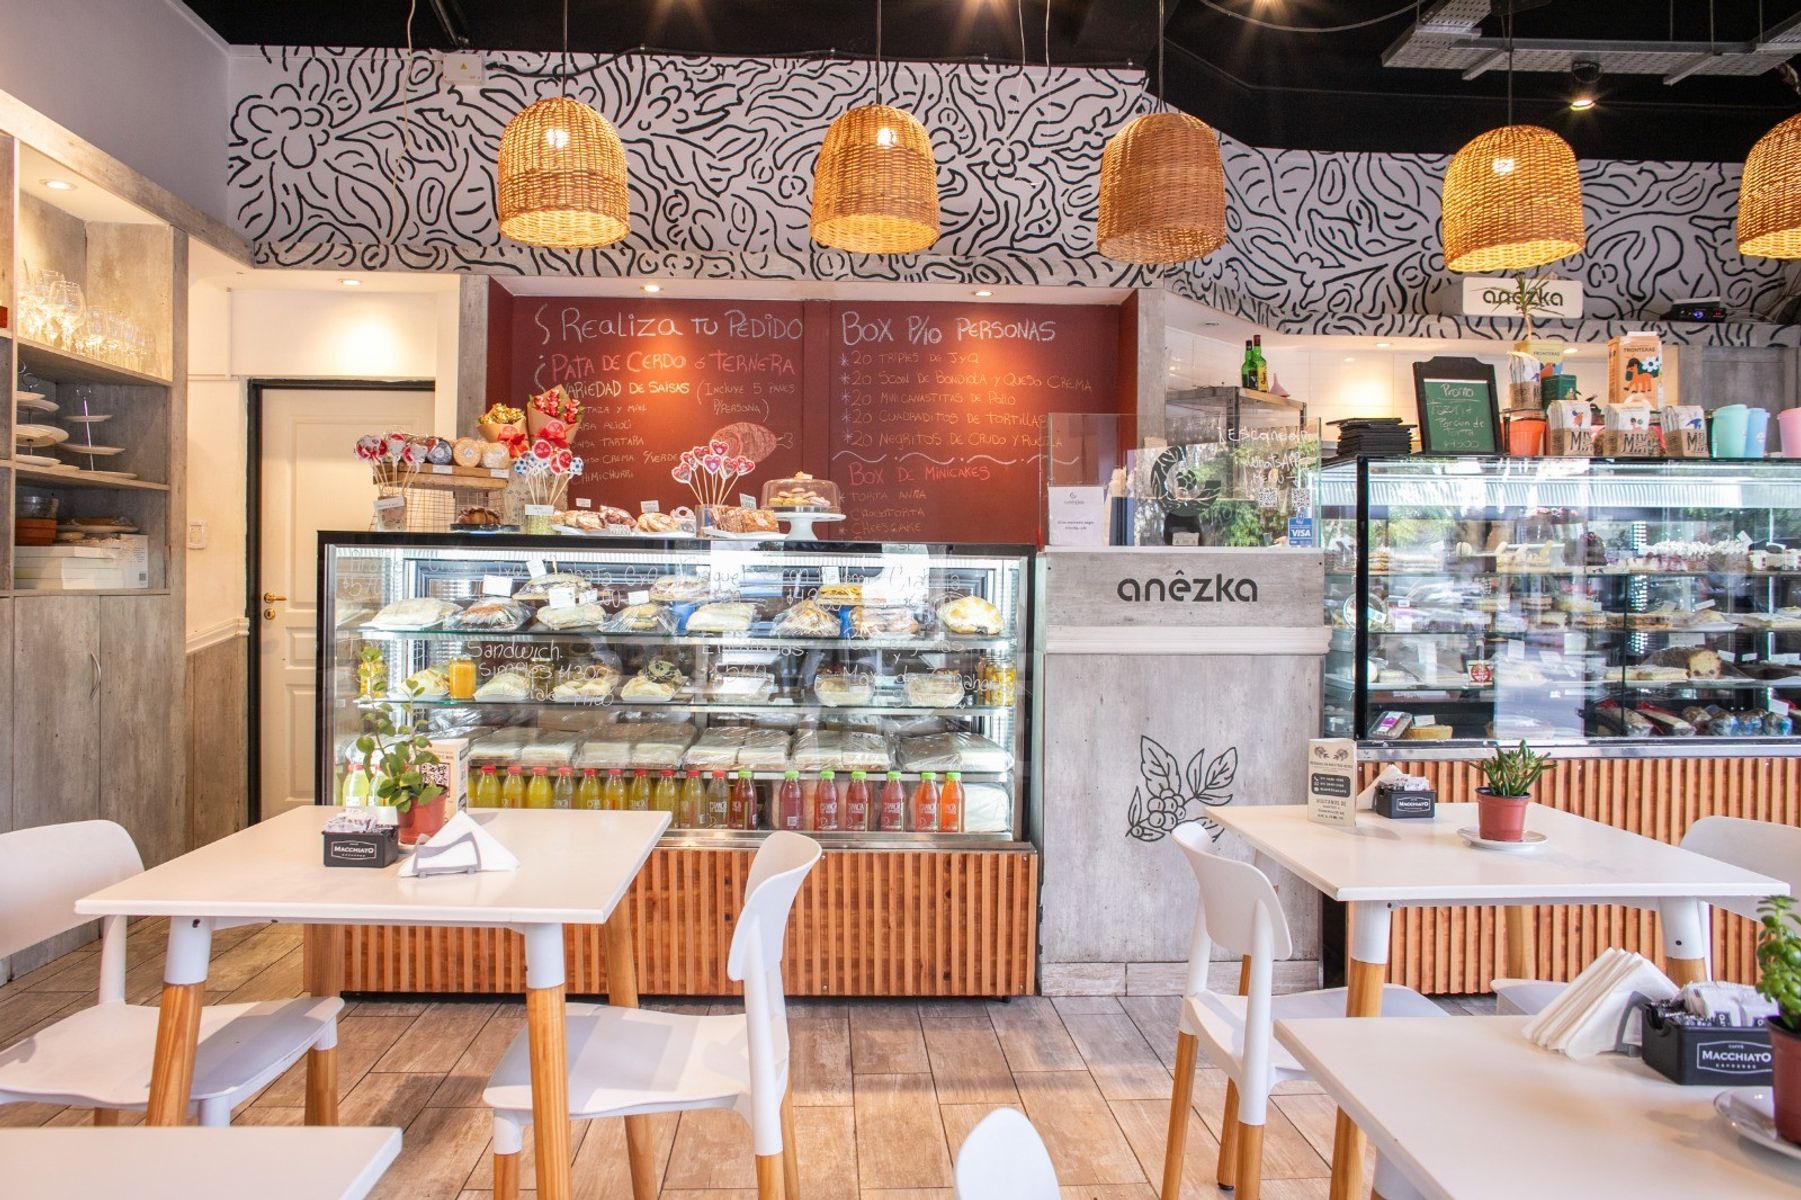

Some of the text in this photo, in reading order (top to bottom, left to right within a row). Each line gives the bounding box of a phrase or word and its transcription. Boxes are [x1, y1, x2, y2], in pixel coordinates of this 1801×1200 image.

[954, 316, 1056, 342] PERSONAS
[552, 353, 595, 382] PATA
[626, 351, 687, 372] CERDO
[708, 350, 795, 375] TERNERA
[1291, 529, 1311, 537] VISA
[1117, 569, 1258, 603] anêzka
[334, 846, 374, 854] MACCHIATO
[1702, 1050, 1772, 1063] MACCHIATO
